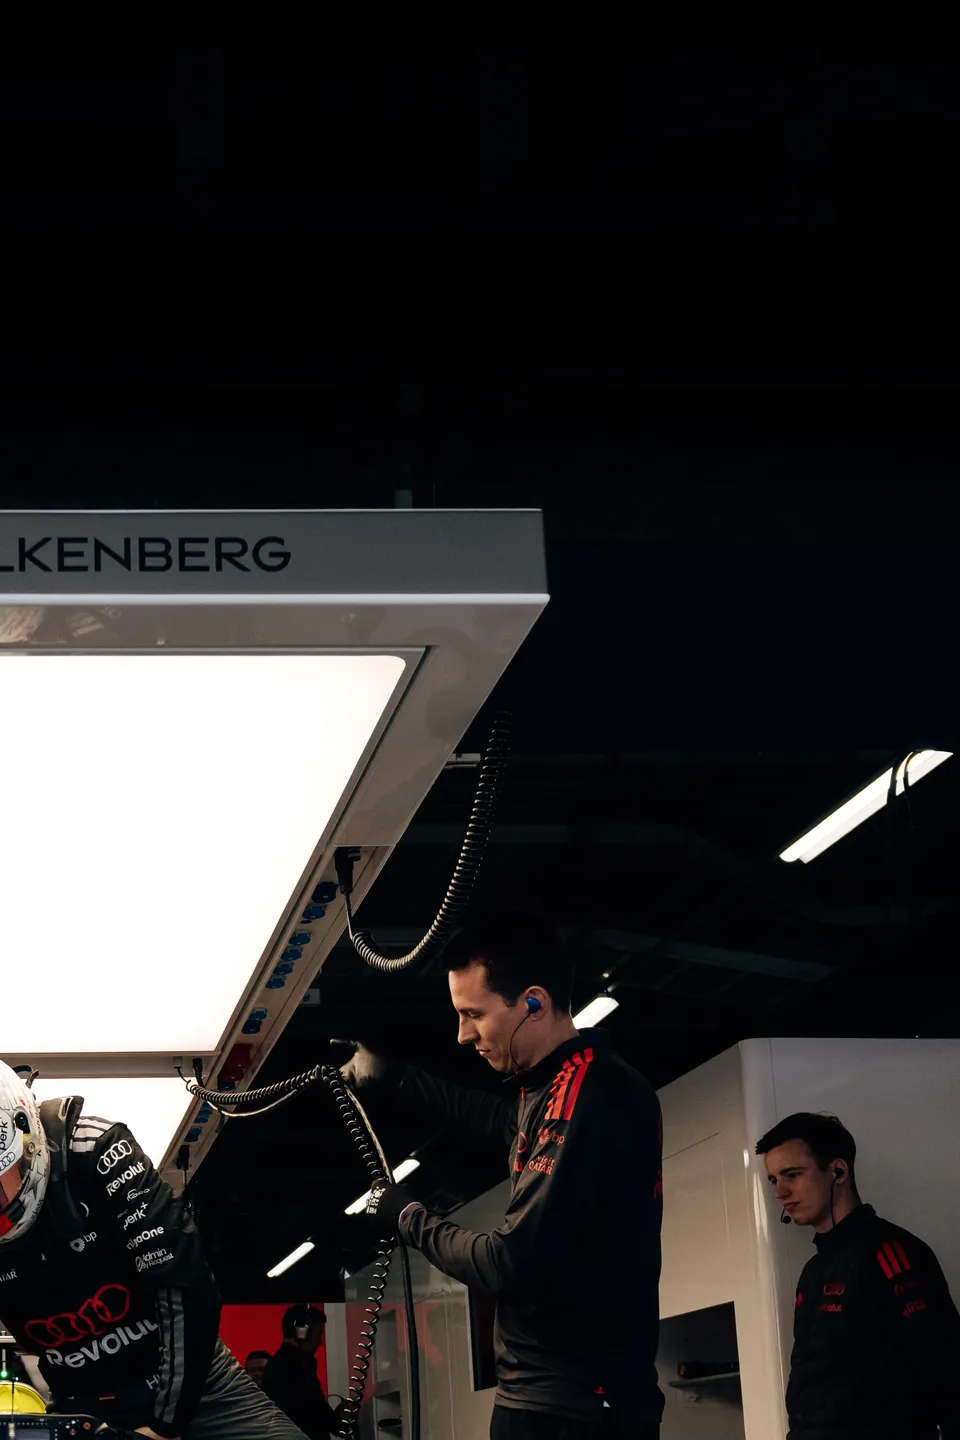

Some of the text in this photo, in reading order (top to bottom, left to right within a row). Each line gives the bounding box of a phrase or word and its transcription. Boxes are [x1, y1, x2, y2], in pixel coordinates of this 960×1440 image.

[552, 1130, 565, 1146] bp
[528, 1160, 553, 1175] QATAR
[84, 1231, 98, 1243] bp
